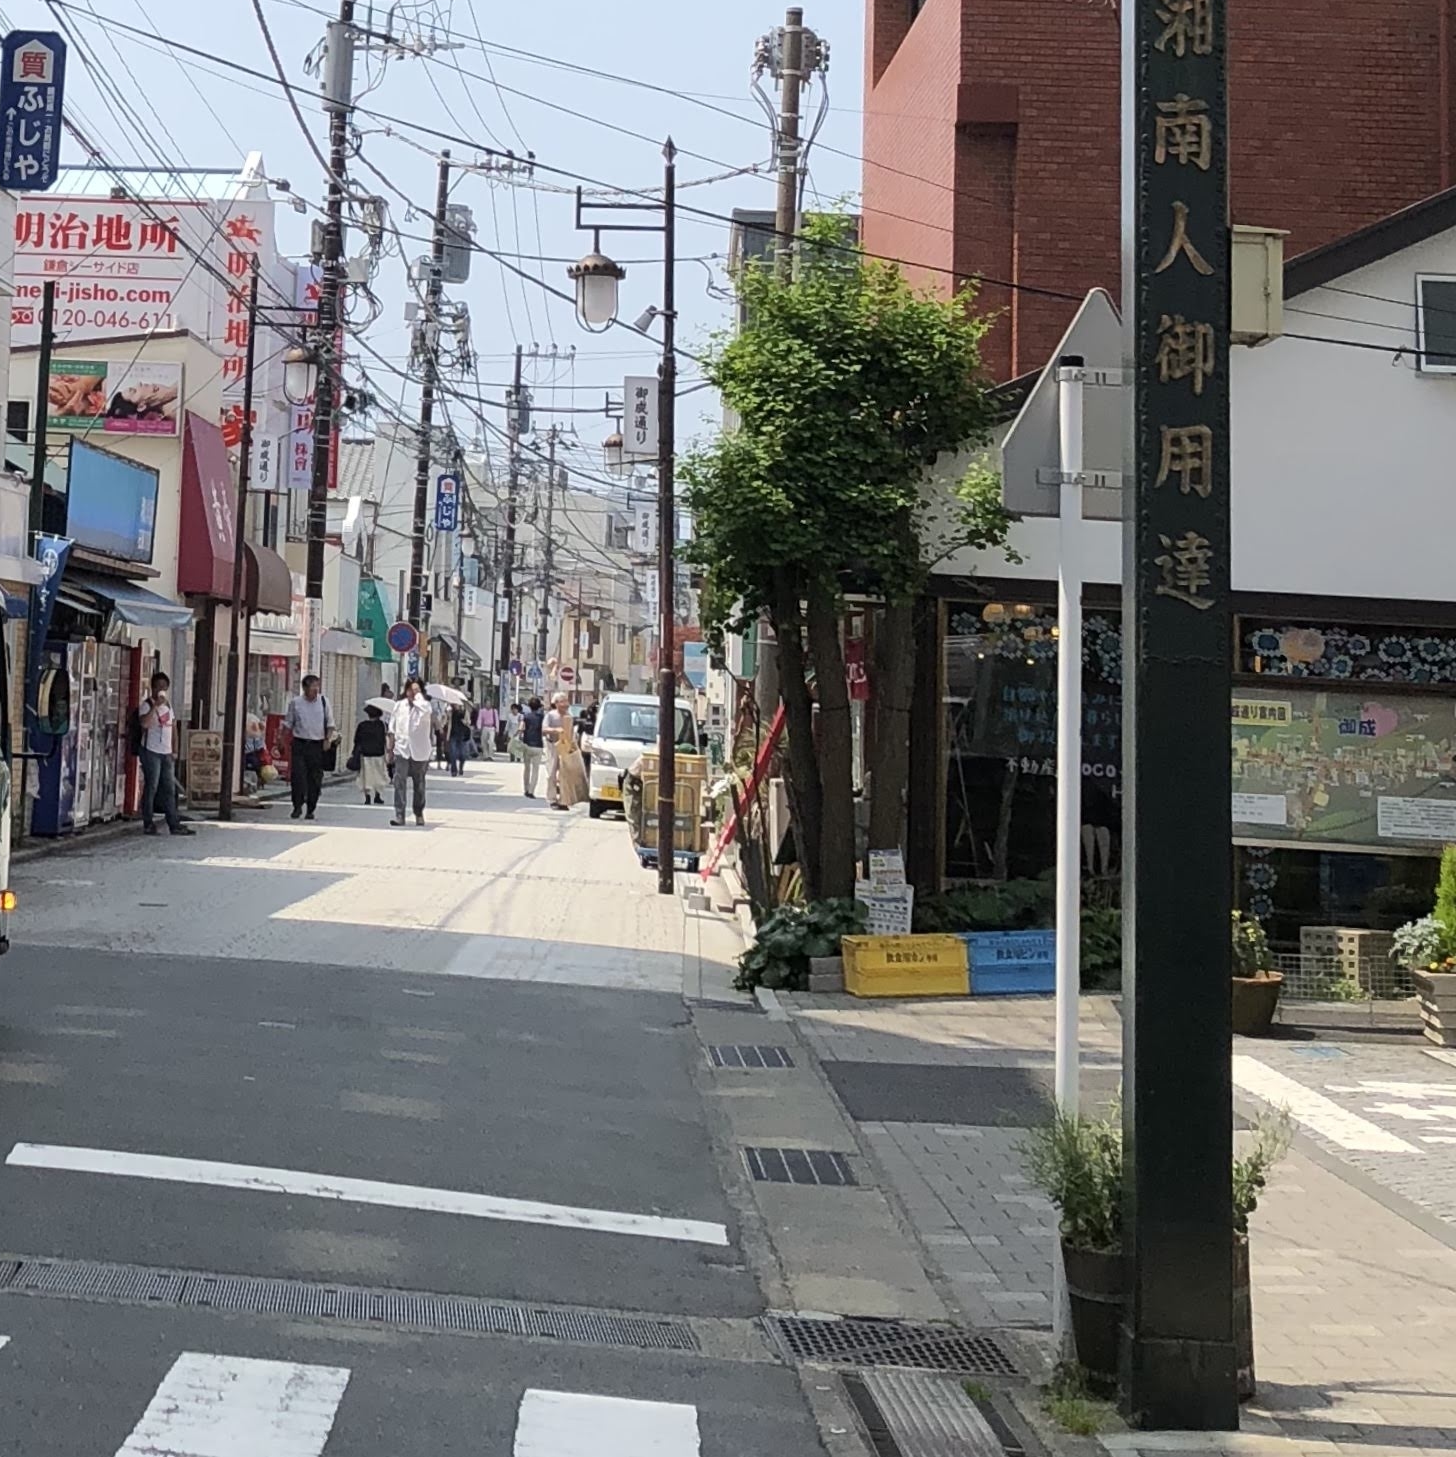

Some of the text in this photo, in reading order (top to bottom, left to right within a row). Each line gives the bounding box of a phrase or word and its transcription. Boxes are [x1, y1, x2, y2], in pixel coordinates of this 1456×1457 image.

[20, 51, 47, 79] 質
[14, 86, 44, 180] ふじや
[15, 211, 181, 253] 明治地所
[43, 258, 140, 275] 鎌倉シーサイド店
[16, 281, 172, 304] mei-jisho.com
[635, 386, 649, 445] 御成通り
